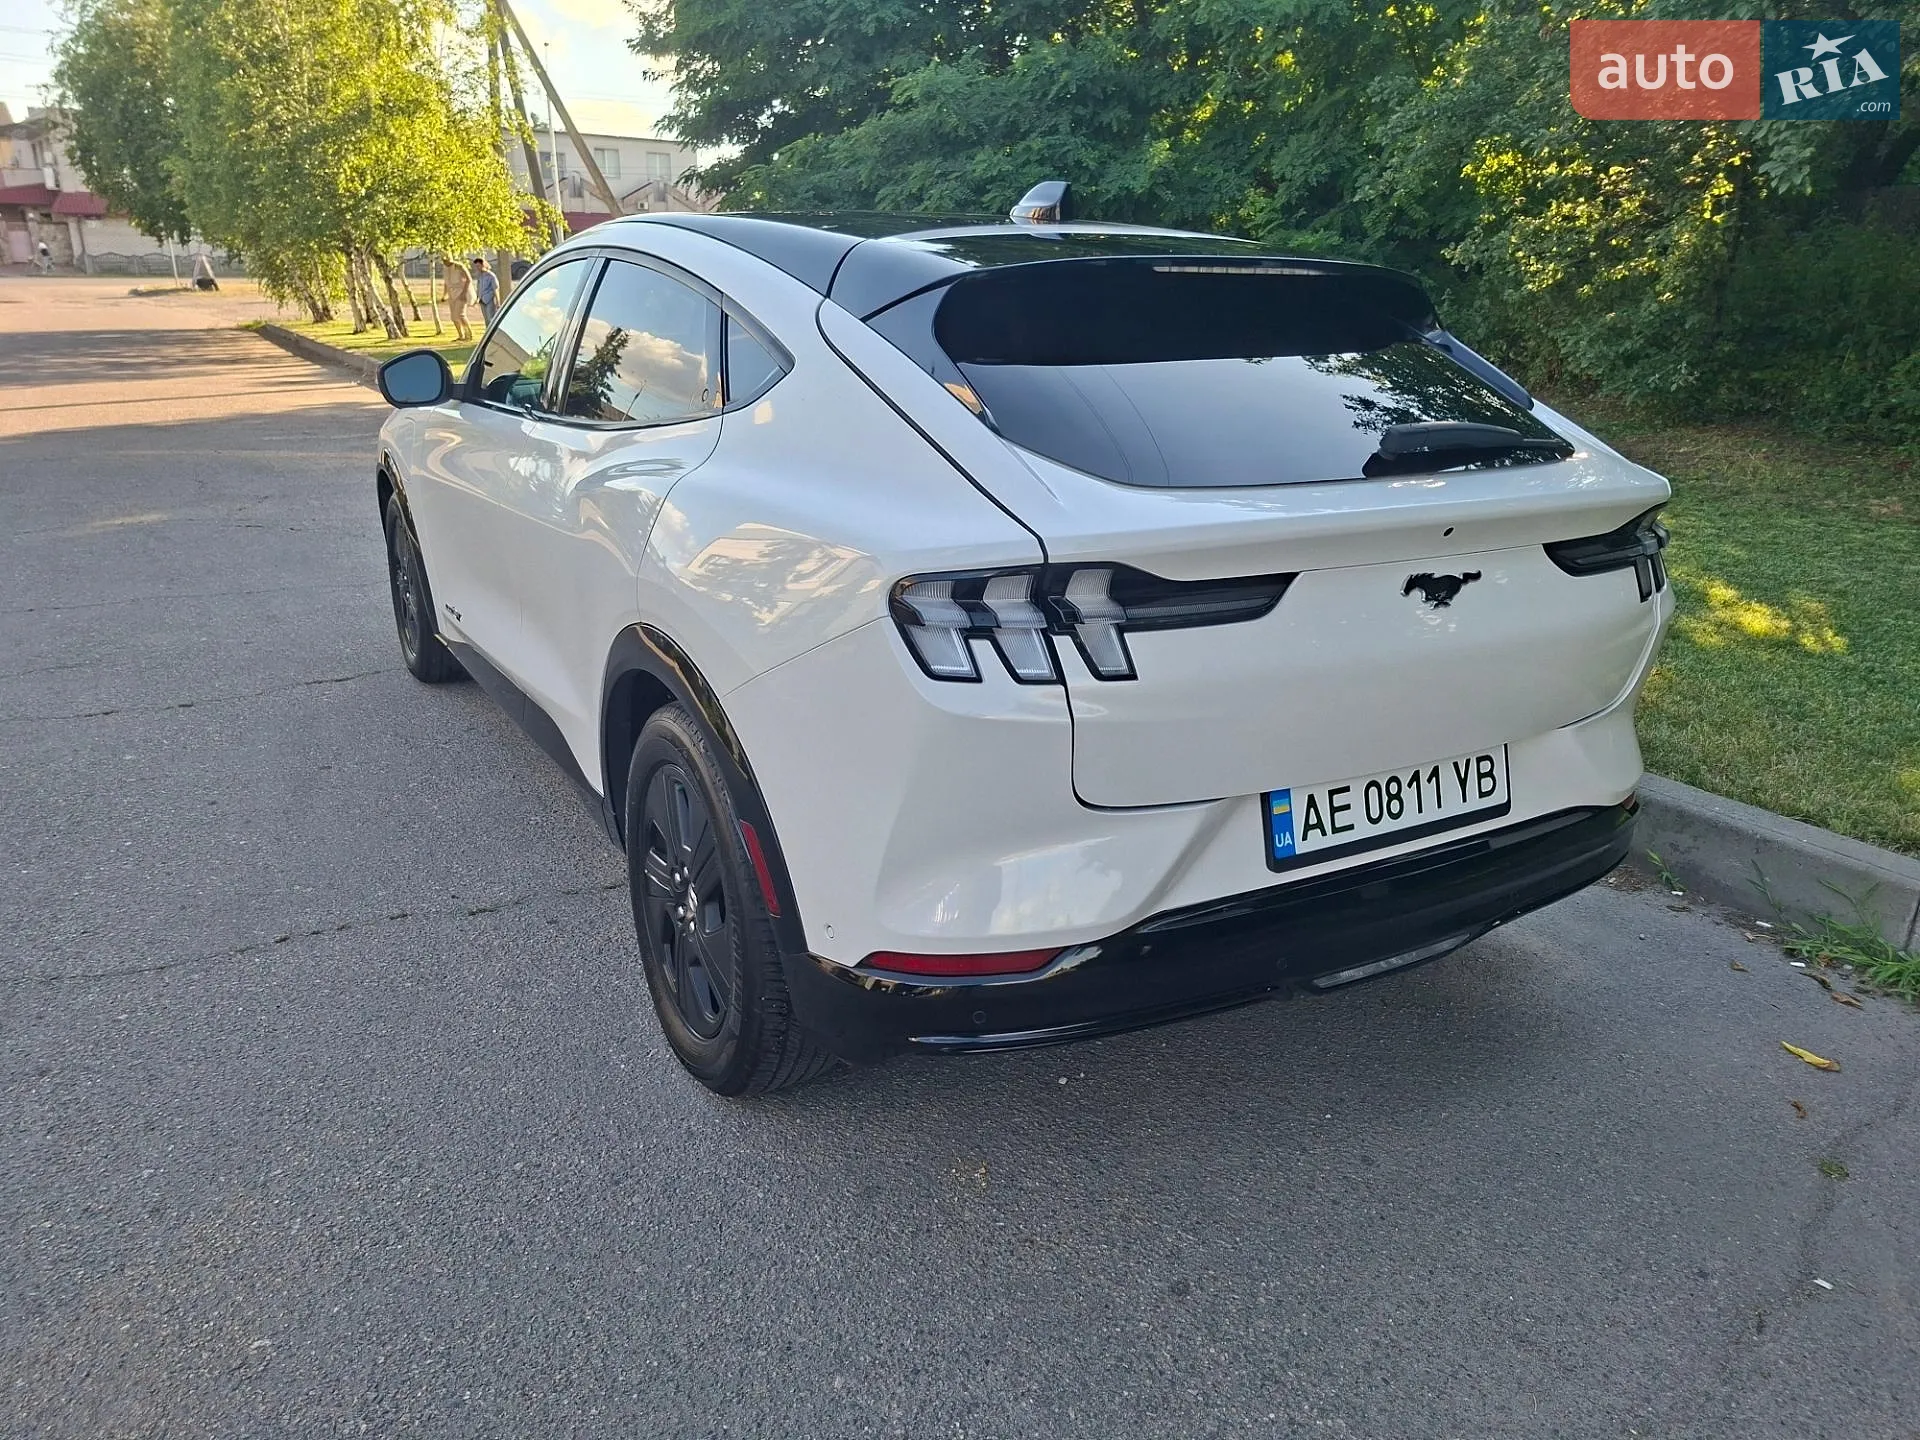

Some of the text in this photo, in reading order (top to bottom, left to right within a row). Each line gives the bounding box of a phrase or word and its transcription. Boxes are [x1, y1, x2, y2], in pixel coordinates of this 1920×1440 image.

[1301, 754, 1497, 841] AE 0811 YB
[1275, 832, 1293, 849] UA
